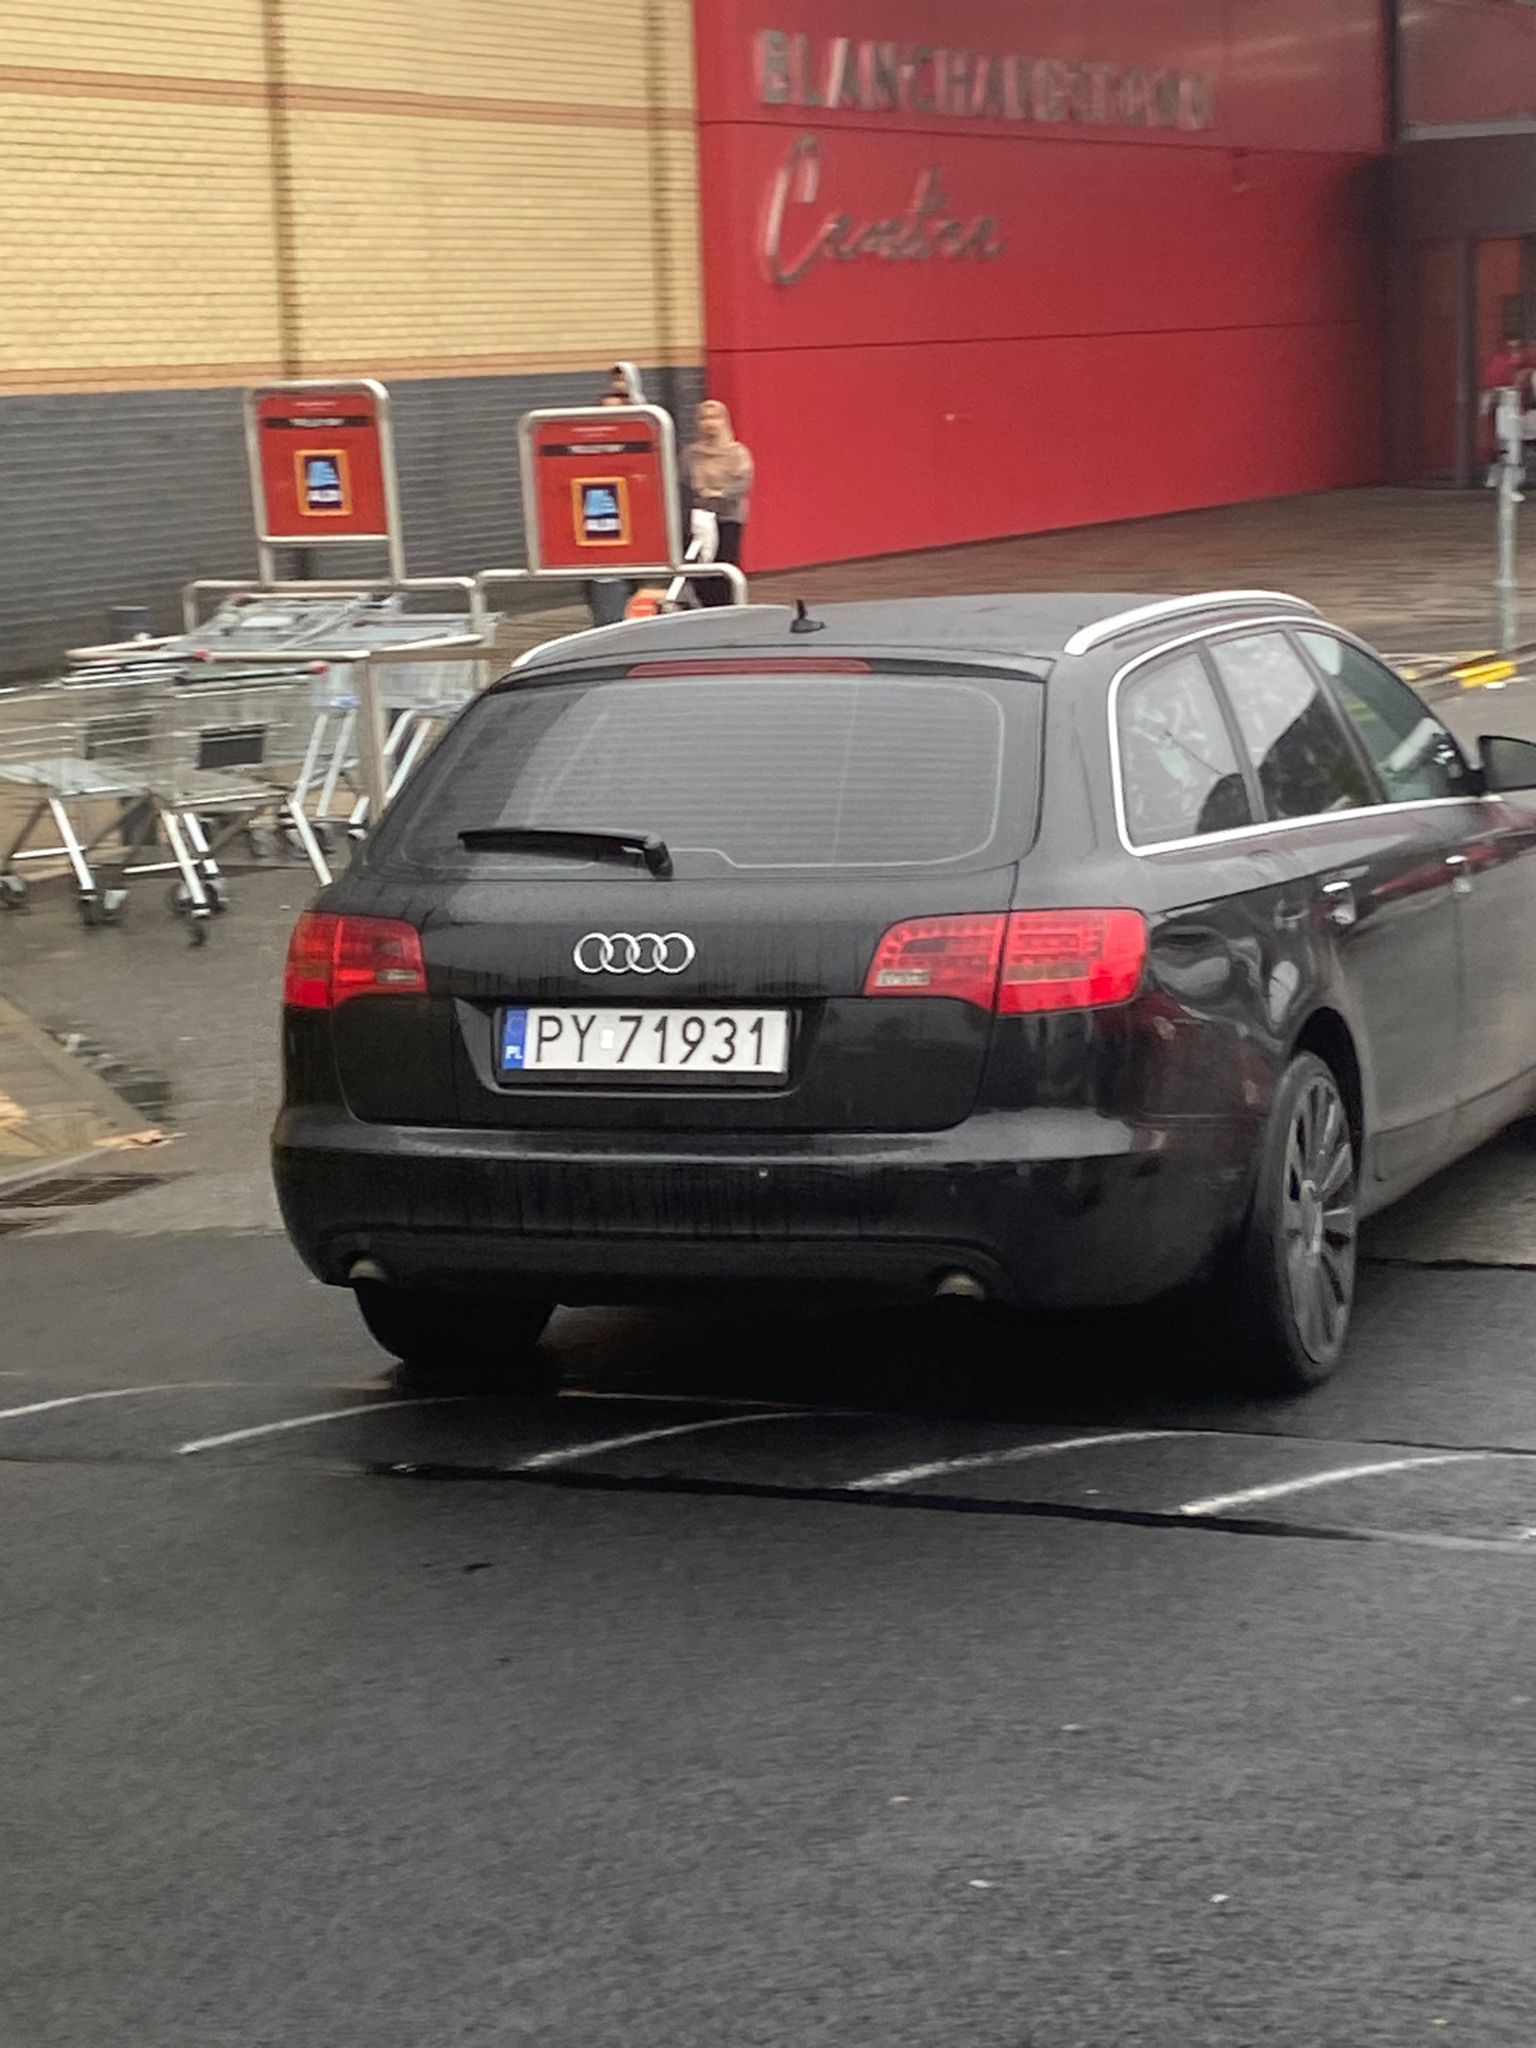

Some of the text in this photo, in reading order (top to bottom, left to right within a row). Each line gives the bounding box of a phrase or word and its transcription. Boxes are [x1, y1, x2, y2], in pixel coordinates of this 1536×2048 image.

[505, 1045, 523, 1060] PL
[535, 1014, 764, 1065] PY 71931
